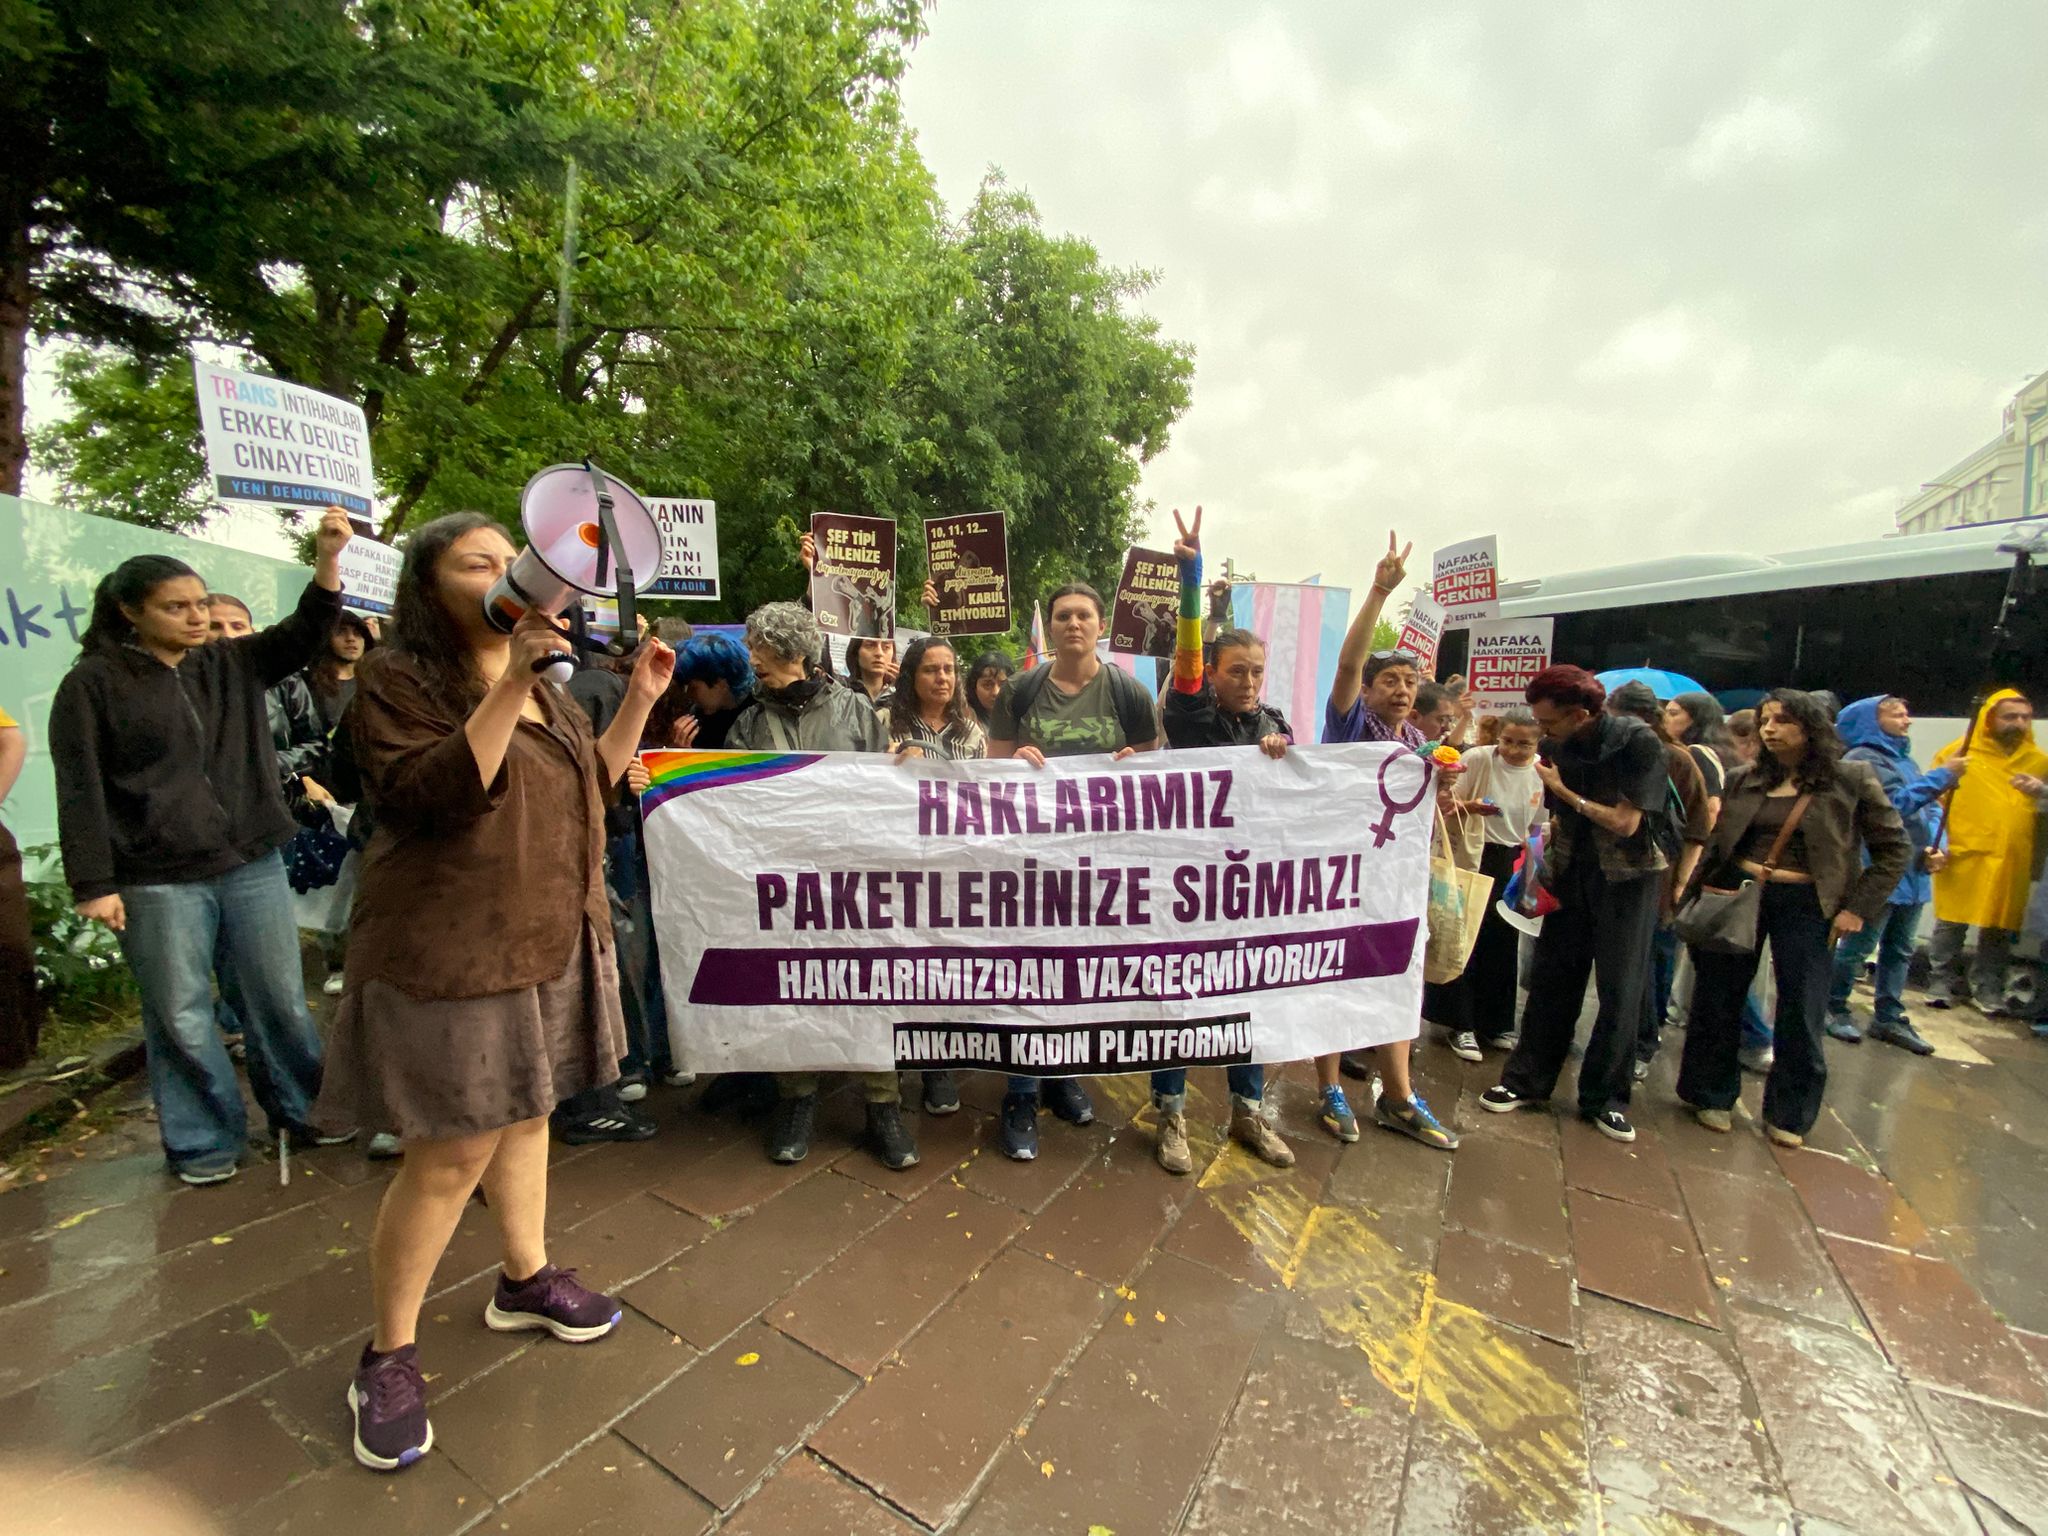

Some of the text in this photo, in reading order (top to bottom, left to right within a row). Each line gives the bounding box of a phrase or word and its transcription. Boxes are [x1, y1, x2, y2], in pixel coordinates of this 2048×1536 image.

[211, 376, 361, 432] TRANS İNTİHARLARI
[219, 407, 359, 459] ERKEK DEVLET
[235, 442, 360, 487] CİNAYETİDİR!
[232, 480, 266, 496] YENİ
[272, 484, 344, 505] DEMOKRAT
[827, 528, 876, 546] ŞEF TİPİ
[930, 527, 946, 539] 10,
[948, 523, 964, 536] 11,
[347, 544, 381, 562] NAFAKA
[825, 544, 881, 564] AİLENİZE
[1437, 551, 1489, 571] NAFAKA
[338, 565, 361, 579] GASP
[362, 572, 389, 588] EDENE
[931, 560, 956, 574] ÇOCUK
[1135, 561, 1178, 578] ŞEF TİPİ
[1435, 561, 1493, 579] HAKKIMIZDAN
[674, 580, 706, 592] KADIN
[1131, 575, 1180, 593] AİLENİZE
[1437, 569, 1491, 592] ELİNİZİ
[968, 591, 1006, 605] KABUL
[1437, 586, 1492, 606] ÇEKİN!
[939, 604, 1006, 622] ETMİYORUZ!
[1412, 607, 1439, 631] NAFAKA
[1403, 630, 1435, 656] ELİNİZİ
[1477, 635, 1542, 647] NAFAKA
[1473, 647, 1546, 656] HAKKIMIZDAN
[1474, 657, 1540, 673] ELİNİZİ
[1474, 671, 1533, 693] ÇEKİN
[919, 769, 1234, 835] HAKLARIMIZ
[756, 849, 1362, 930] PAKETLERİNİZE SIĞMAZ!
[778, 938, 1346, 1001] HAKLARIMIZDAN VAZGEÇMİYORUZ!
[895, 1021, 1252, 1065] ANKARA KADIN PLATFORMU
